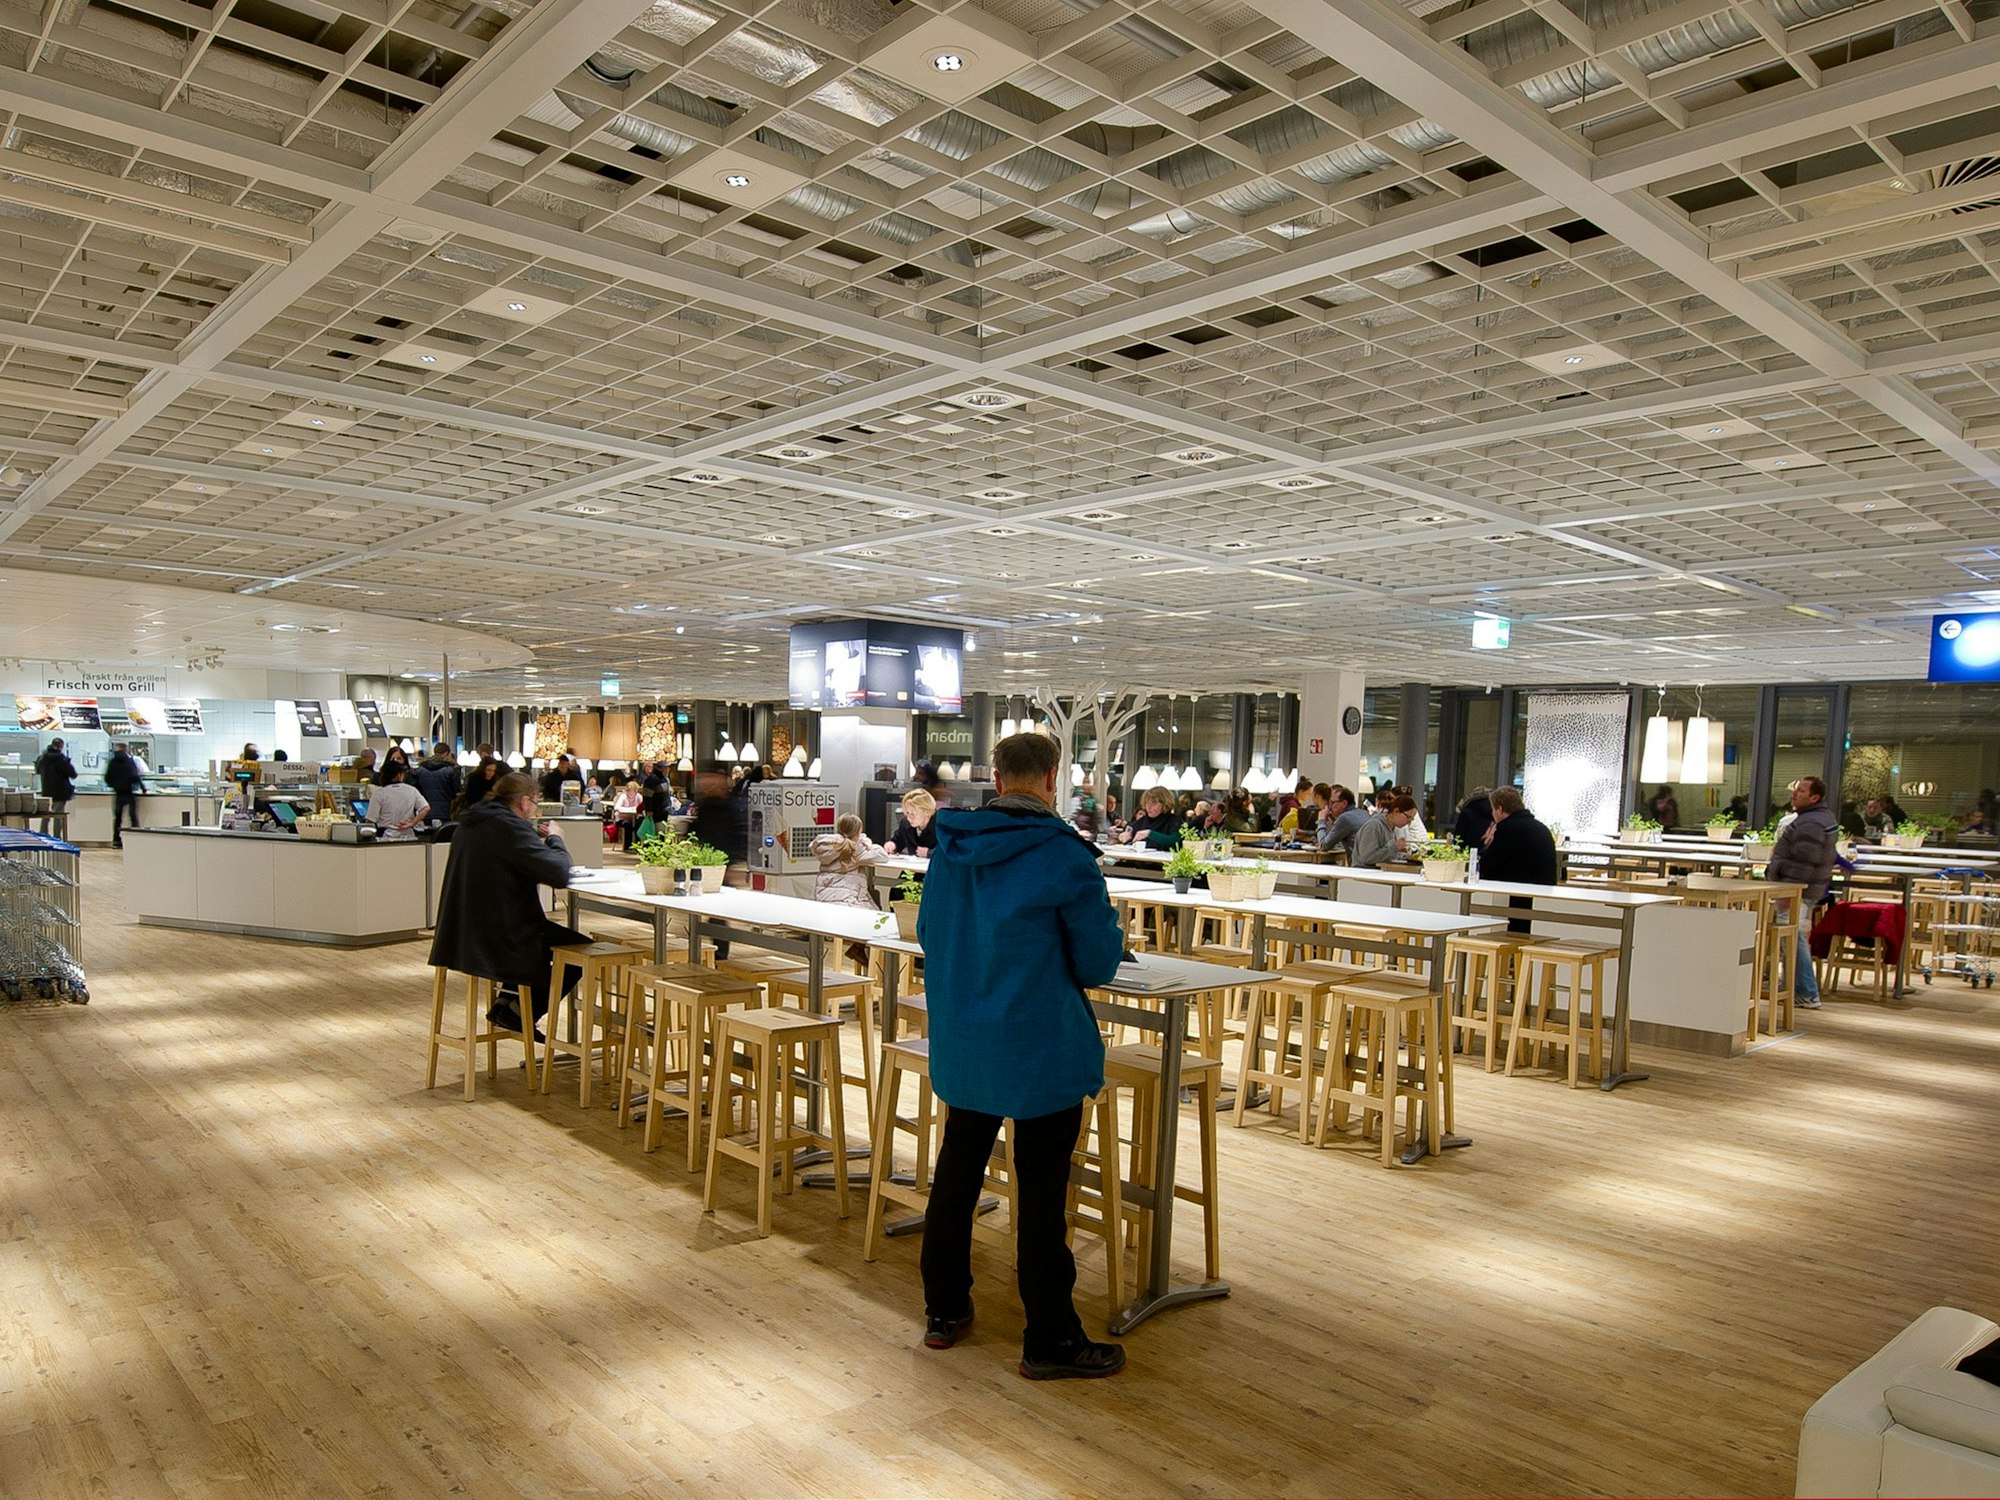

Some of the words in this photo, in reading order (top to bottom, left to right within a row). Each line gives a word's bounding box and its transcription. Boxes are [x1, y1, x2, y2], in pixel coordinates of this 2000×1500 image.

[82, 672, 111, 681] färskt
[114, 672, 134, 681] från
[136, 674, 166, 683] grillen
[47, 679, 89, 690] Frisch
[95, 682, 123, 691] vom
[127, 682, 155, 692] Grill
[784, 790, 835, 807] Softeis
